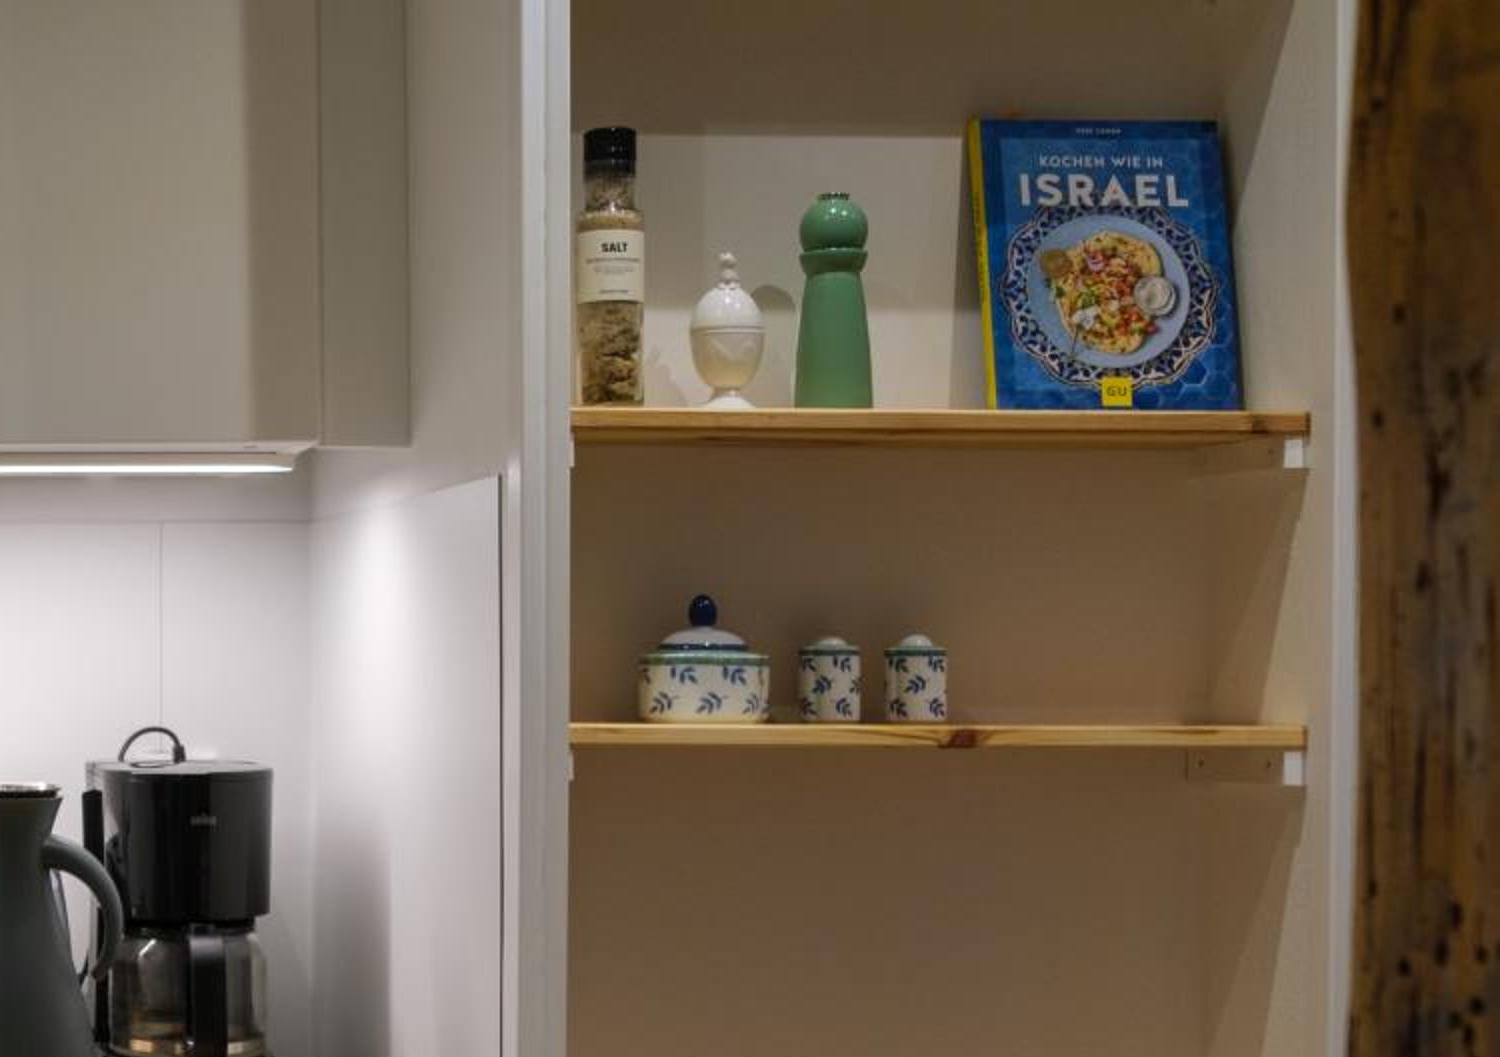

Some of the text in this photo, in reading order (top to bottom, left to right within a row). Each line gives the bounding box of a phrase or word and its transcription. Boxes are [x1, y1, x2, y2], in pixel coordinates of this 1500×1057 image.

[1039, 154, 1164, 169] KOCHEN WIE IN
[1017, 172, 1190, 208] ISRAEL
[601, 242, 628, 253] SALT
[1106, 385, 1128, 397] GU
